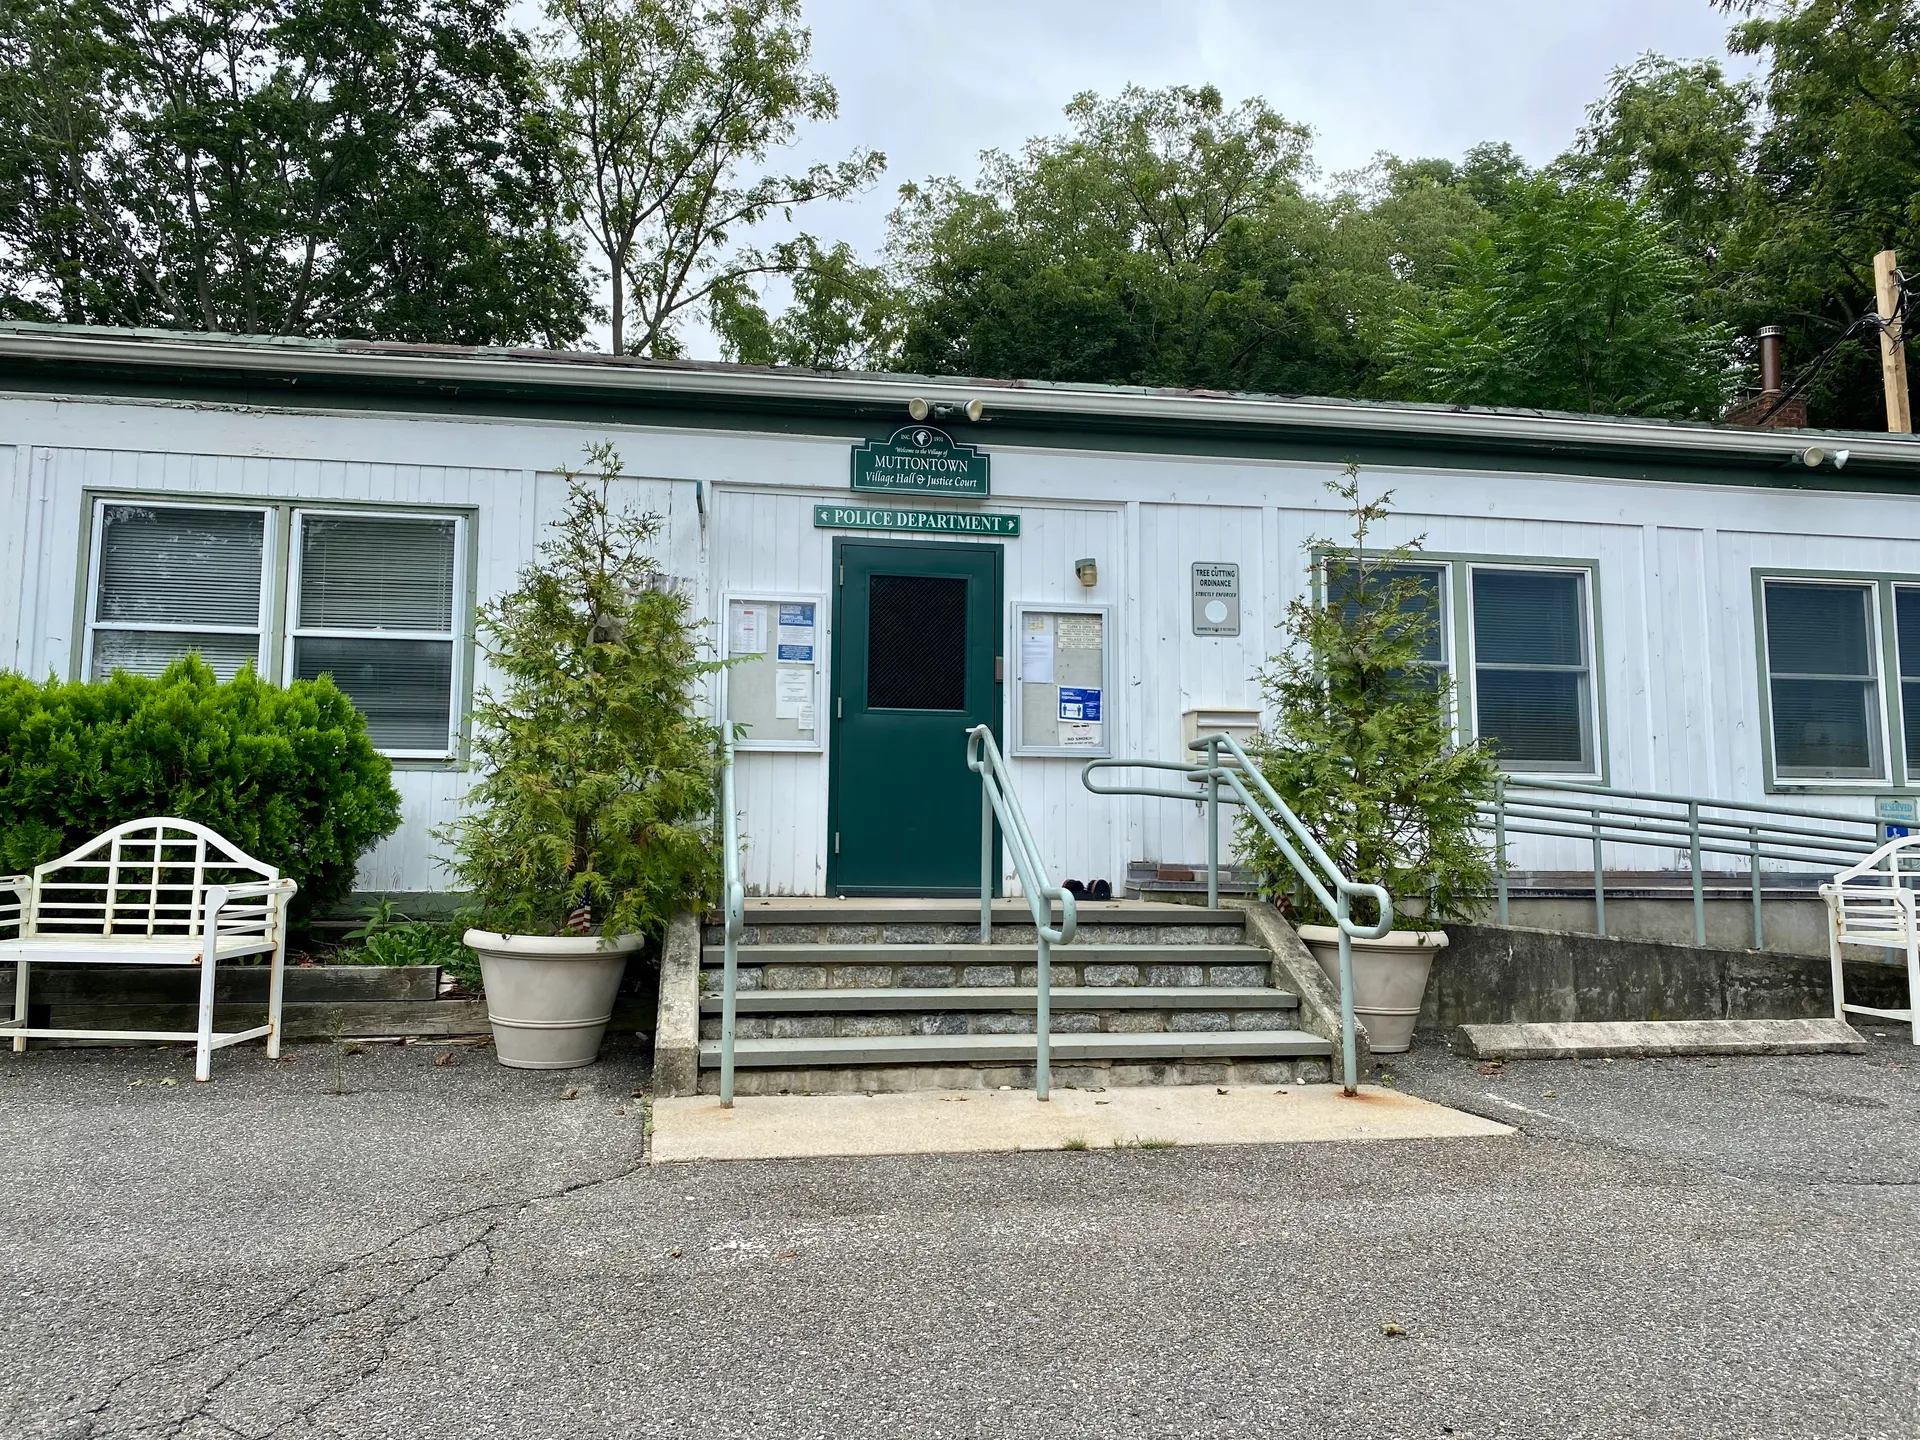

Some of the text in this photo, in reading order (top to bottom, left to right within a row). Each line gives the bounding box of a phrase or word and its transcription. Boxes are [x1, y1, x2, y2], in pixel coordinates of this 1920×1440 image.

[928, 448, 942, 457] Village
[942, 449, 948, 457] of
[875, 455, 968, 472] MUTTONTOWN
[866, 470, 894, 486] Village
[896, 472, 916, 484] Hall
[927, 475, 953, 487] Justice
[954, 477, 977, 488] Court
[834, 509, 1002, 531] POLICE DEPARTMENT
[1196, 569, 1236, 578] TREE CUTTING
[1199, 579, 1232, 587] ORDINANCE
[1880, 802, 1912, 812] RESERVED
